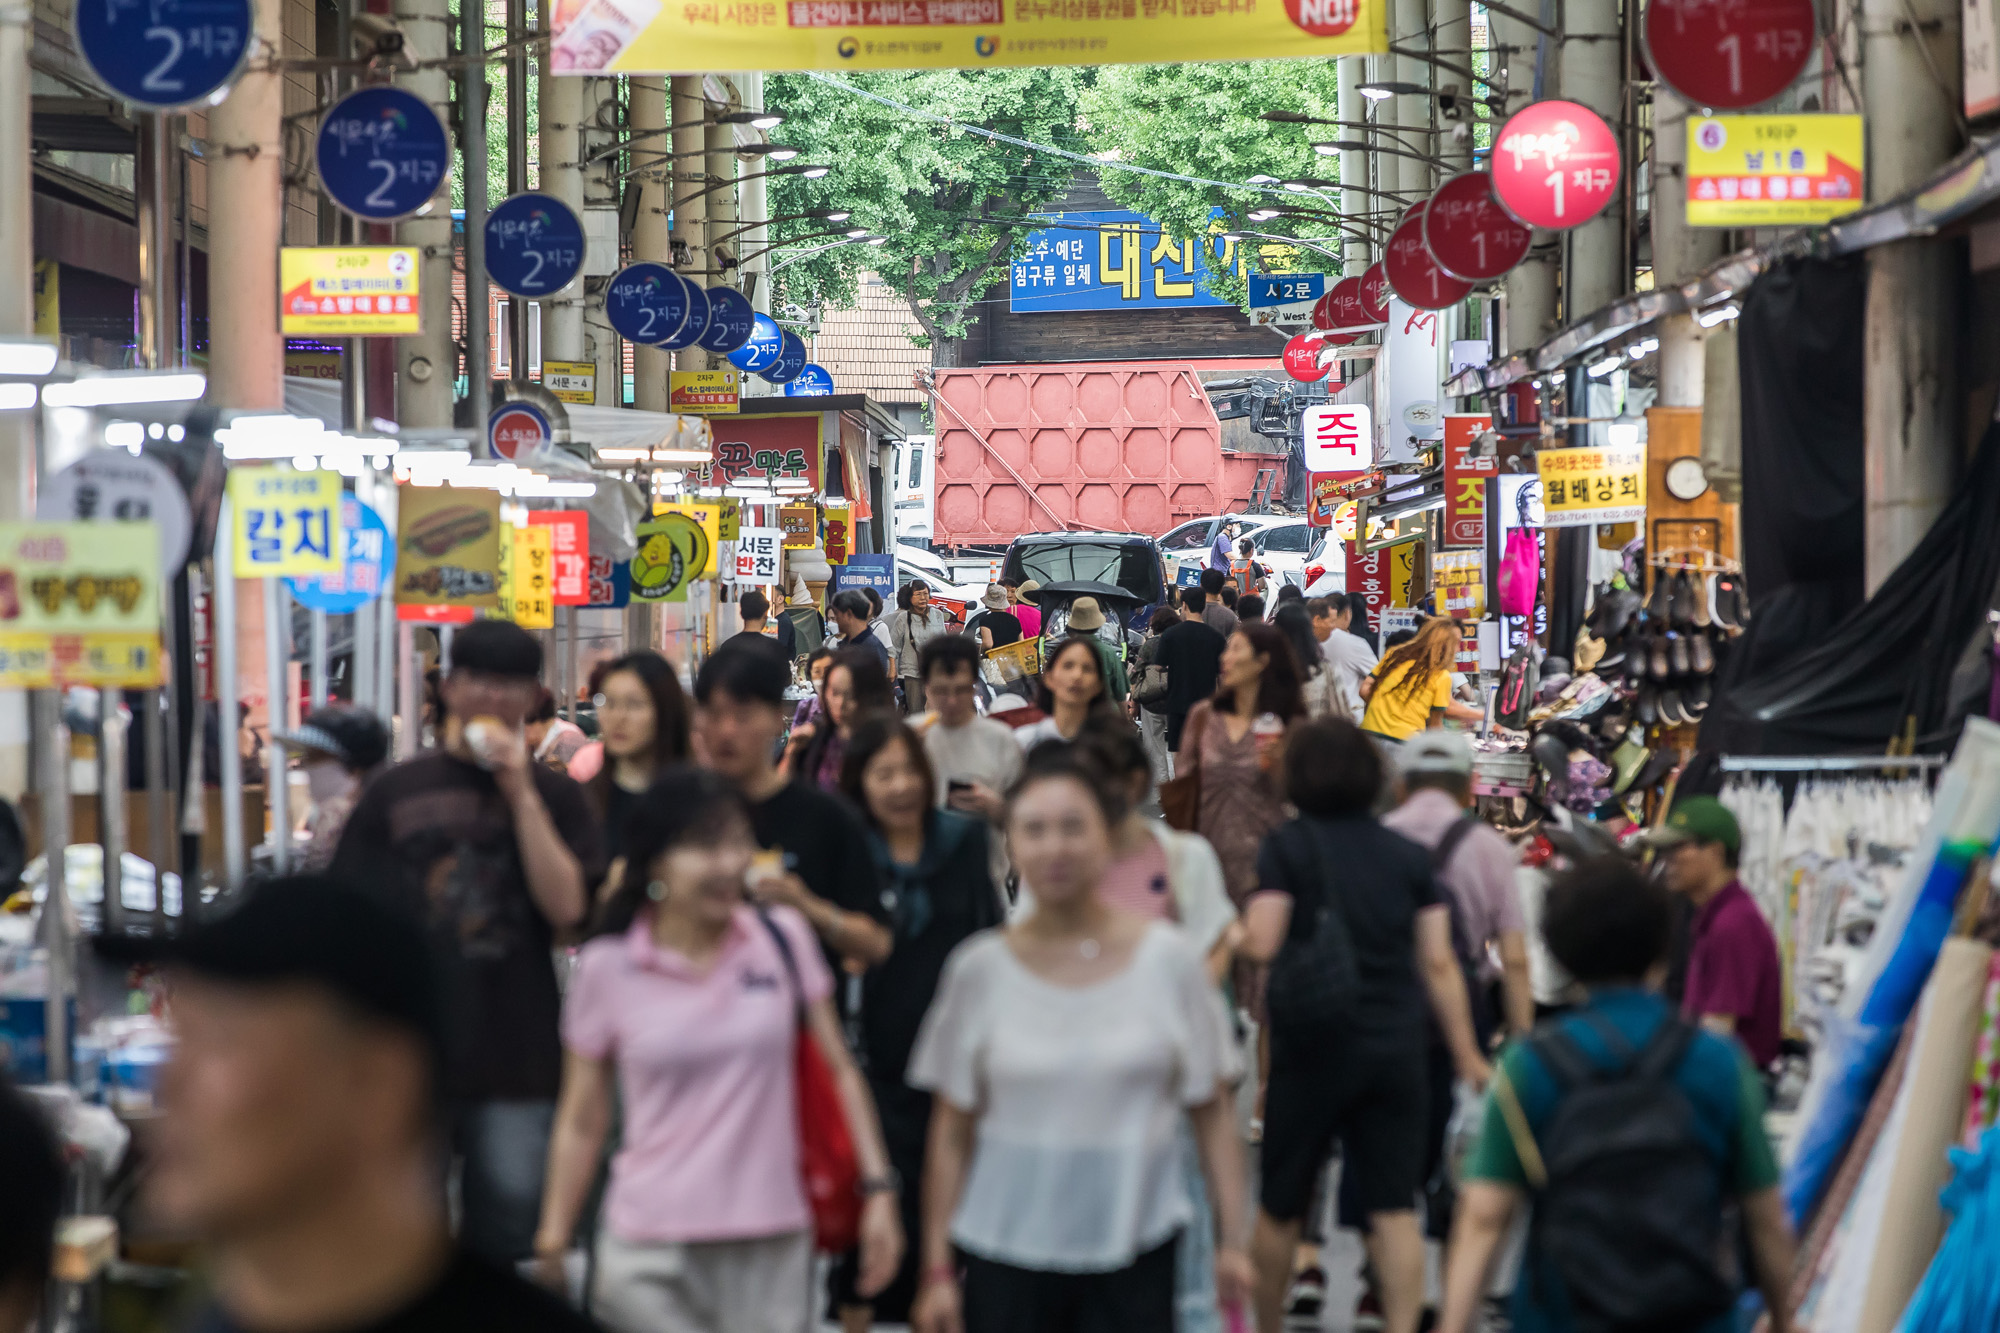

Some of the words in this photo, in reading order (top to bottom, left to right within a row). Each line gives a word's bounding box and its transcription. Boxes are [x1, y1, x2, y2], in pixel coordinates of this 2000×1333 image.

[683, 3, 719, 26] 우리
[725, 1, 777, 27] 시장은
[868, 0, 925, 26] 서비스
[1301, 0, 1354, 26] NO!
[394, 254, 406, 271] 2
[1015, 265, 1056, 287] 침구류
[1063, 263, 1091, 285] 일체
[1283, 313, 1306, 321] West
[551, 376, 571, 389] 서문
[580, 378, 588, 388] 4
[697, 374, 714, 382] 2지구
[726, 373, 731, 384] 1
[690, 395, 715, 403] 소방대
[718, 395, 734, 403] 통로
[1317, 413, 1359, 456] 죽
[1548, 474, 1638, 505] 월배상회
[739, 537, 773, 554] 서문
[825, 520, 846, 564] 호떡
[736, 556, 775, 576] 반찬
[840, 575, 872, 585] 여름메뉴
[874, 575, 891, 585] 출시
